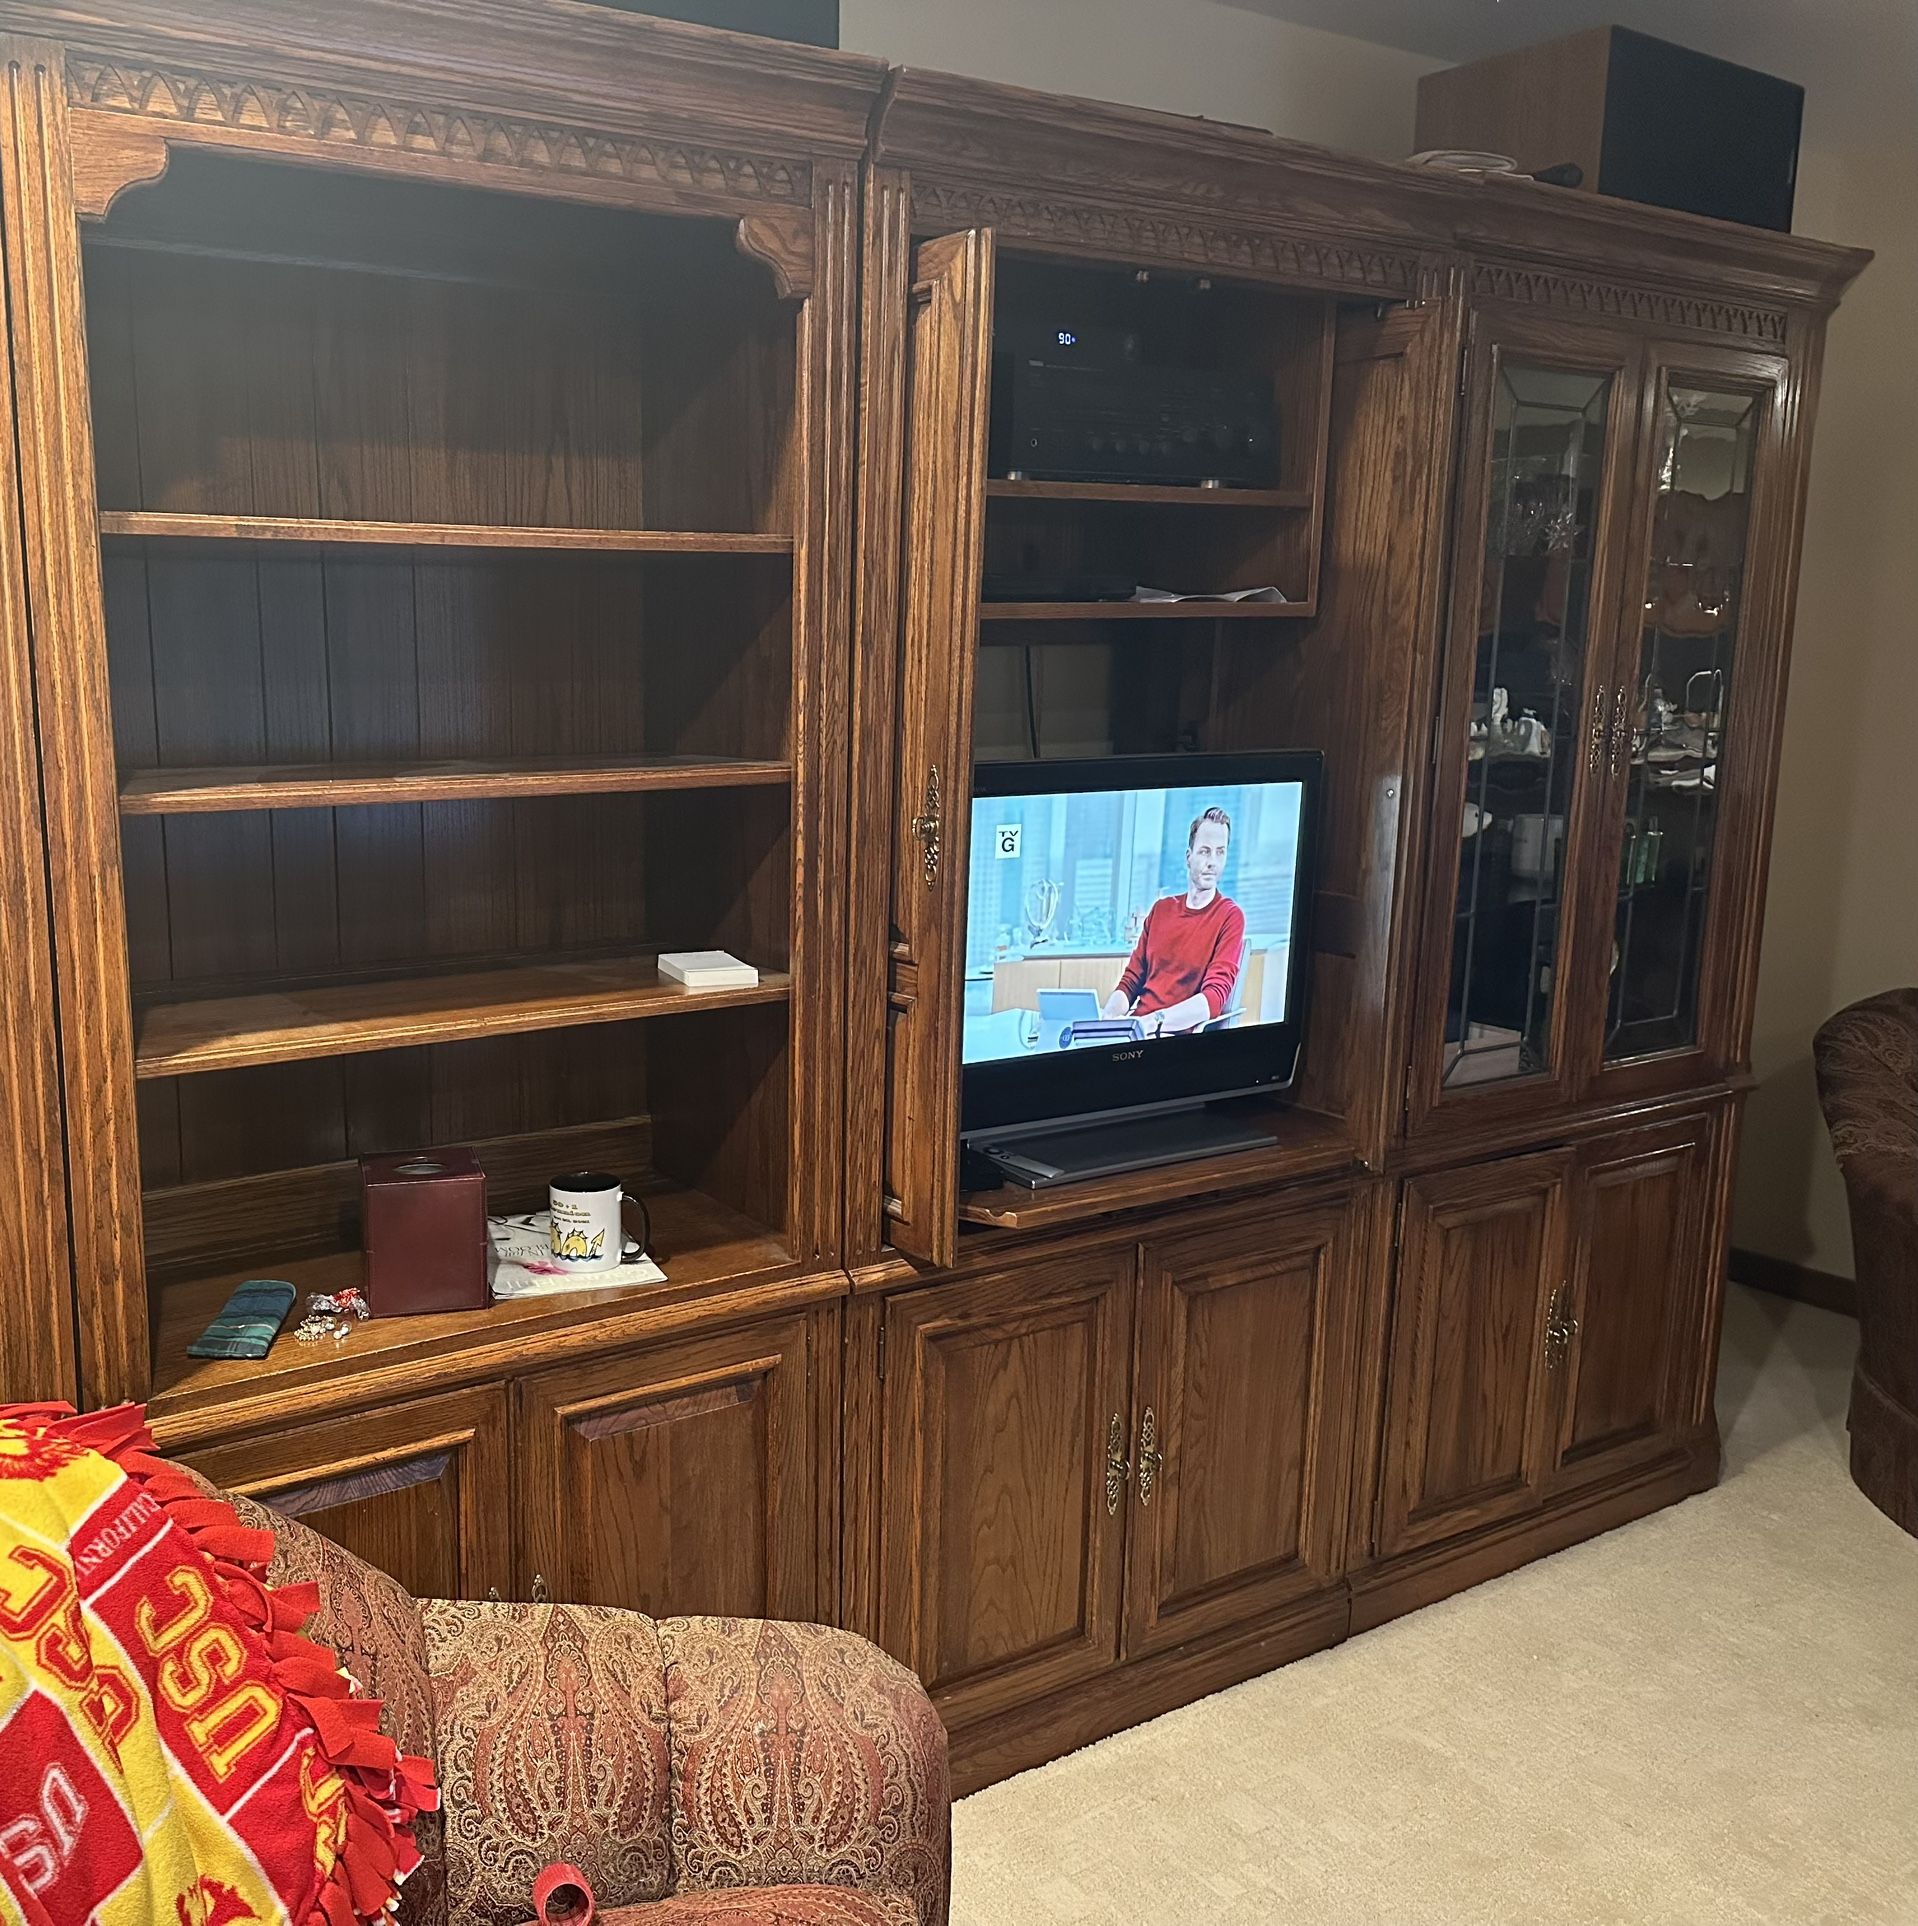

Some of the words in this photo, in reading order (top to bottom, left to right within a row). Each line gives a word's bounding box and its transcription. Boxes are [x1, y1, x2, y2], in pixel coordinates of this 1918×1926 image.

[1058, 332, 1071, 345] 90
[1001, 837, 1015, 853] G
[1112, 1050, 1144, 1062] SONY
[75, 1492, 161, 1581] CALIFORN
[134, 1565, 286, 1784] USC
